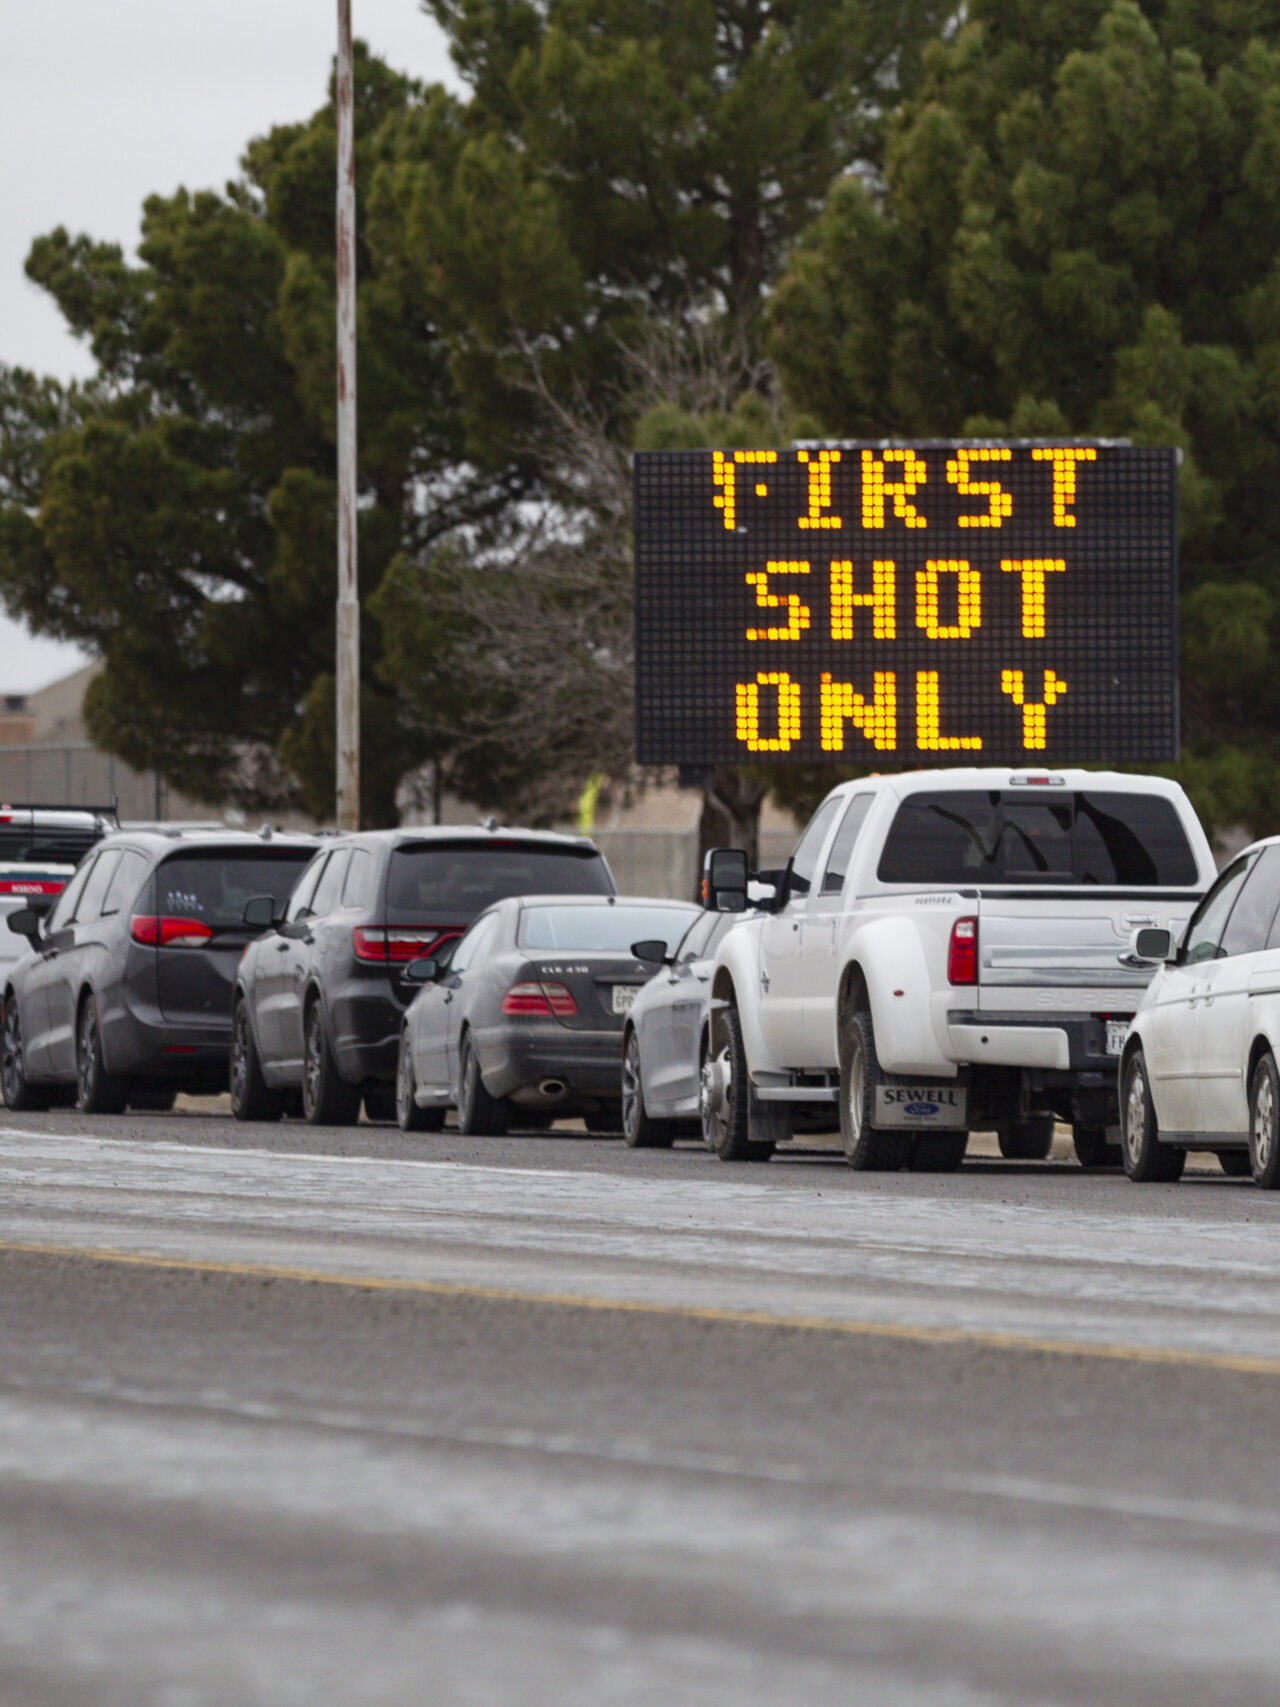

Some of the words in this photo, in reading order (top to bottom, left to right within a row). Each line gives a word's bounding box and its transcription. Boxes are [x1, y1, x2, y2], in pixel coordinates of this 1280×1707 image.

[712, 449, 1097, 530] FIRST
[745, 559, 1066, 640] SHOT
[735, 670, 1067, 752] ONLY
[1035, 990, 1141, 1008] SUPER
[883, 1088, 959, 1107] SEWELL
